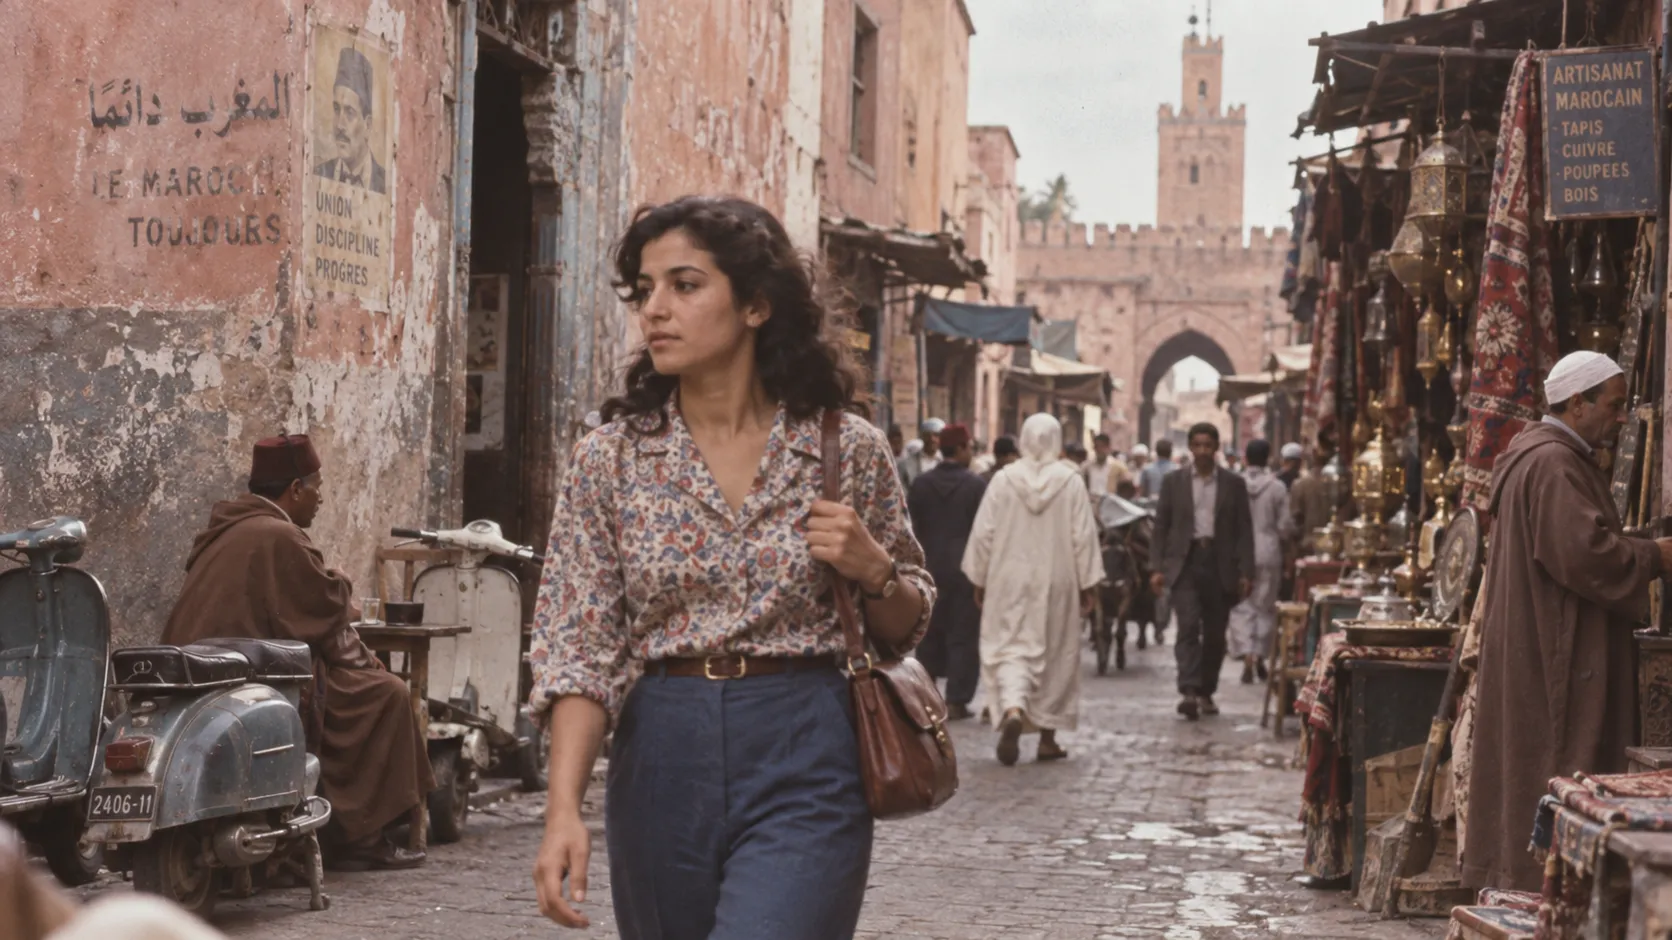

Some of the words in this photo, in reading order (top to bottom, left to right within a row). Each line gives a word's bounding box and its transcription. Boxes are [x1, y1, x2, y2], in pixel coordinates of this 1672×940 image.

[1553, 60, 1643, 85] ARTISANAT
[179, 69, 290, 139] المغرب
[1555, 87, 1642, 110] MAROCAIN
[1561, 119, 1604, 137] TAPIS
[1561, 141, 1617, 158] CUIVRE
[142, 166, 244, 197] MAROC
[1563, 162, 1630, 180] POUPEES
[316, 190, 353, 219] UNION
[1564, 185, 1599, 203] BOIS
[128, 213, 281, 248] TOUJOURS
[315, 223, 381, 258] DISCIPLINE
[93, 794, 152, 814] 2406-11
